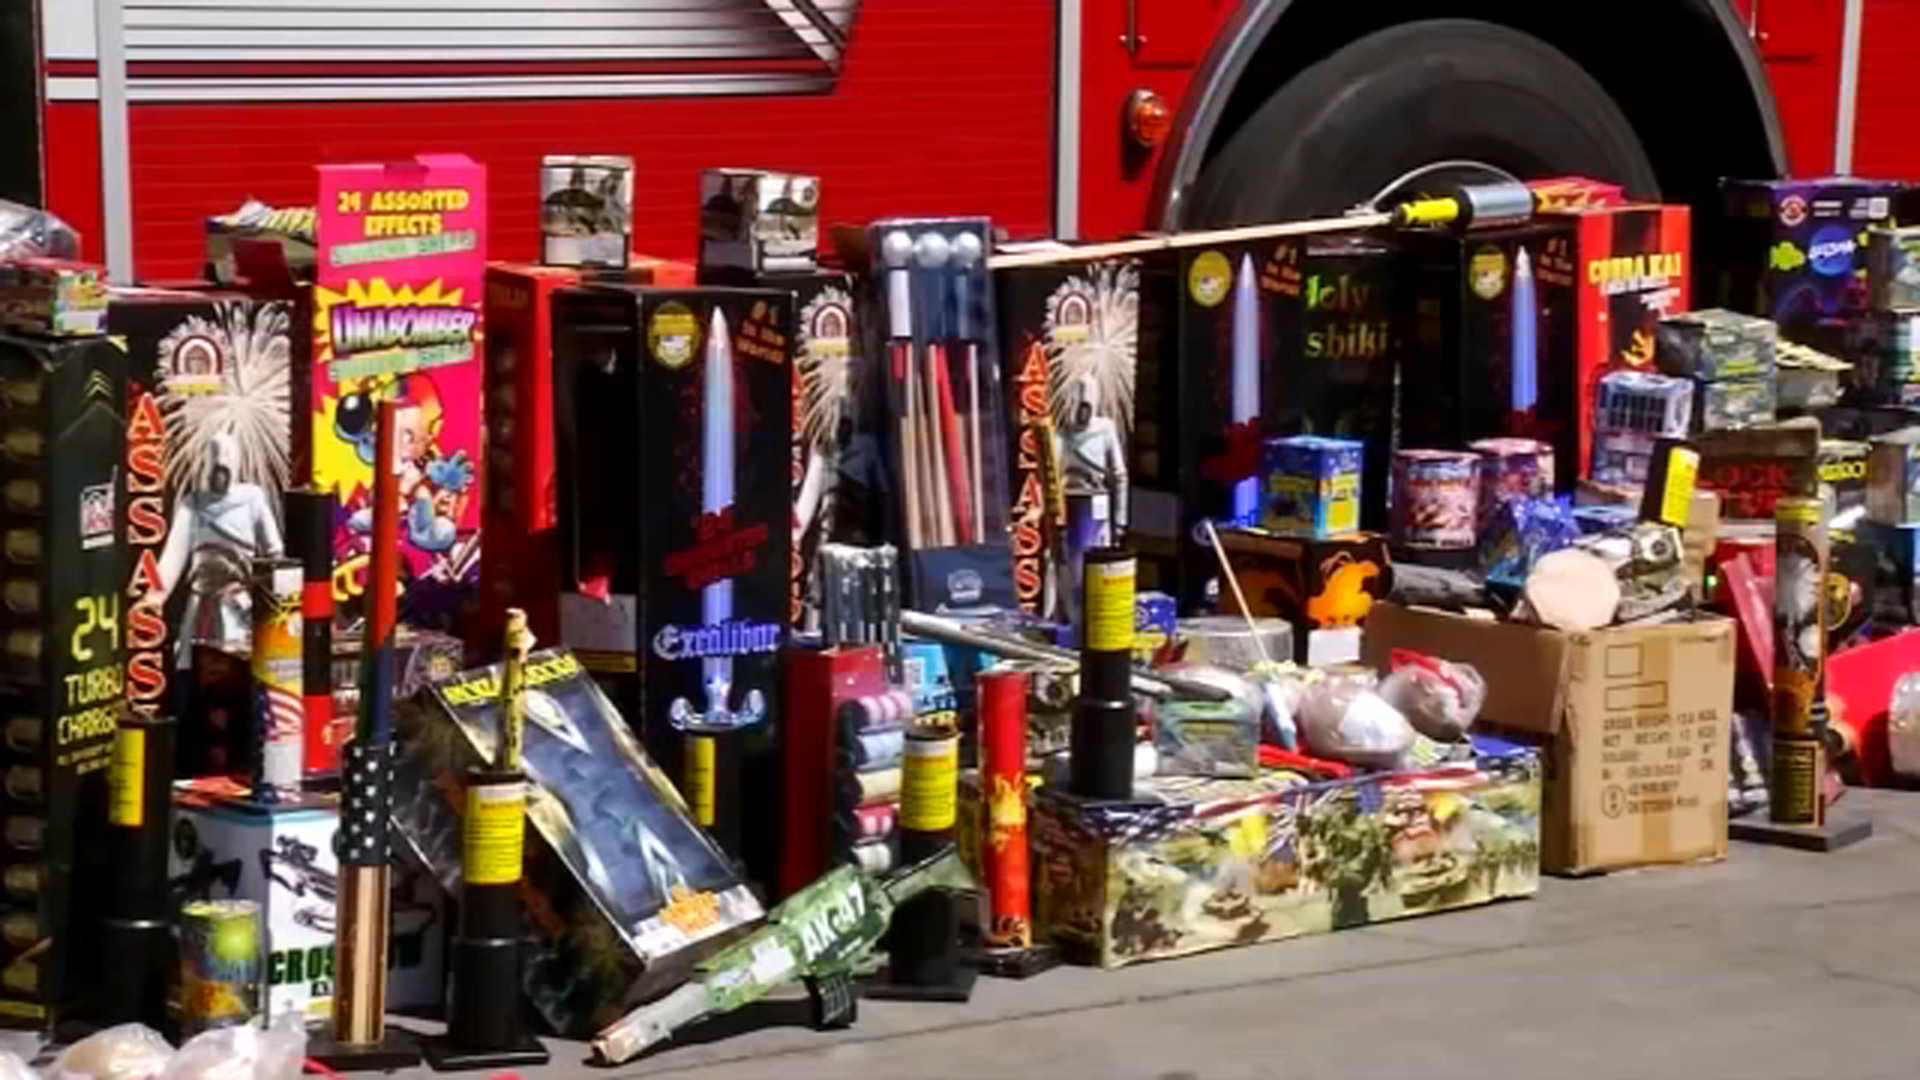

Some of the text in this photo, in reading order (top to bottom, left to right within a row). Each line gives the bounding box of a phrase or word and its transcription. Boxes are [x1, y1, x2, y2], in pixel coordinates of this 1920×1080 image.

[337, 189, 469, 213] 24 ASSORTED
[364, 213, 443, 237] EFFECTS
[332, 302, 478, 355] UNABOMBER
[71, 592, 119, 662] 24
[652, 619, 780, 661] Excalibur
